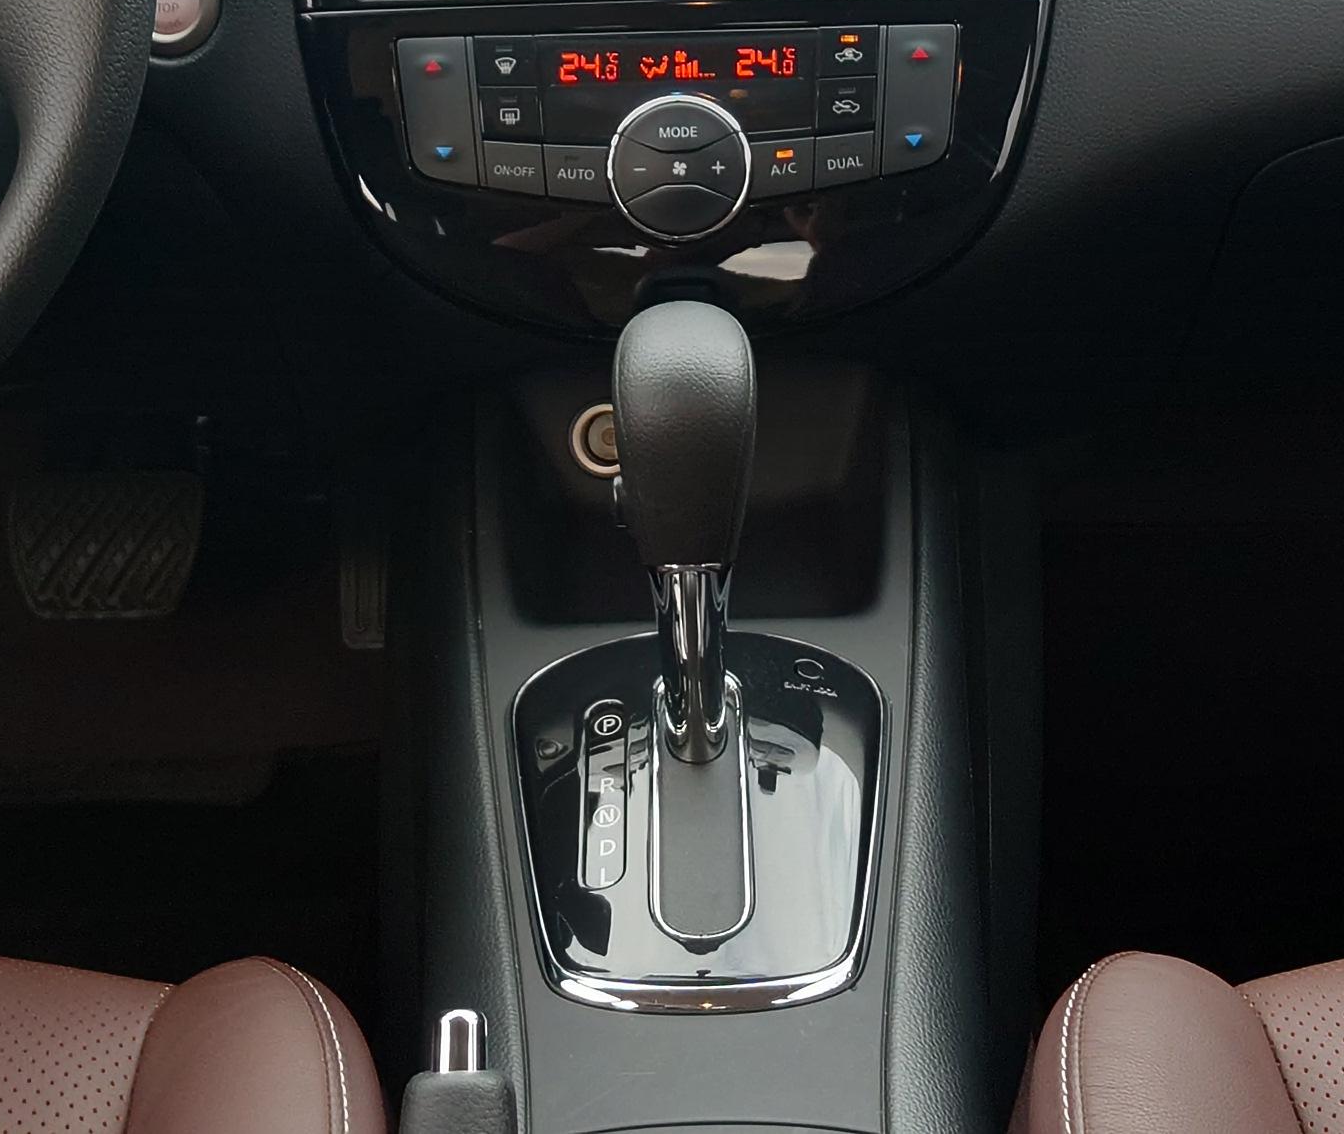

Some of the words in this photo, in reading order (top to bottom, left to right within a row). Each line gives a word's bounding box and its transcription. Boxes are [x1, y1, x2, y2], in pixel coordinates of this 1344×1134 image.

[157, 2, 179, 13] TOP
[659, 126, 698, 138] MODE
[771, 162, 797, 176] A/C
[827, 156, 863, 170] DUAL
[557, 168, 595, 181] AUTO
[602, 718, 616, 732] P
[600, 777, 615, 794] R
[599, 808, 615, 823] N
[600, 839, 616, 856] D
[600, 868, 613, 886] L
